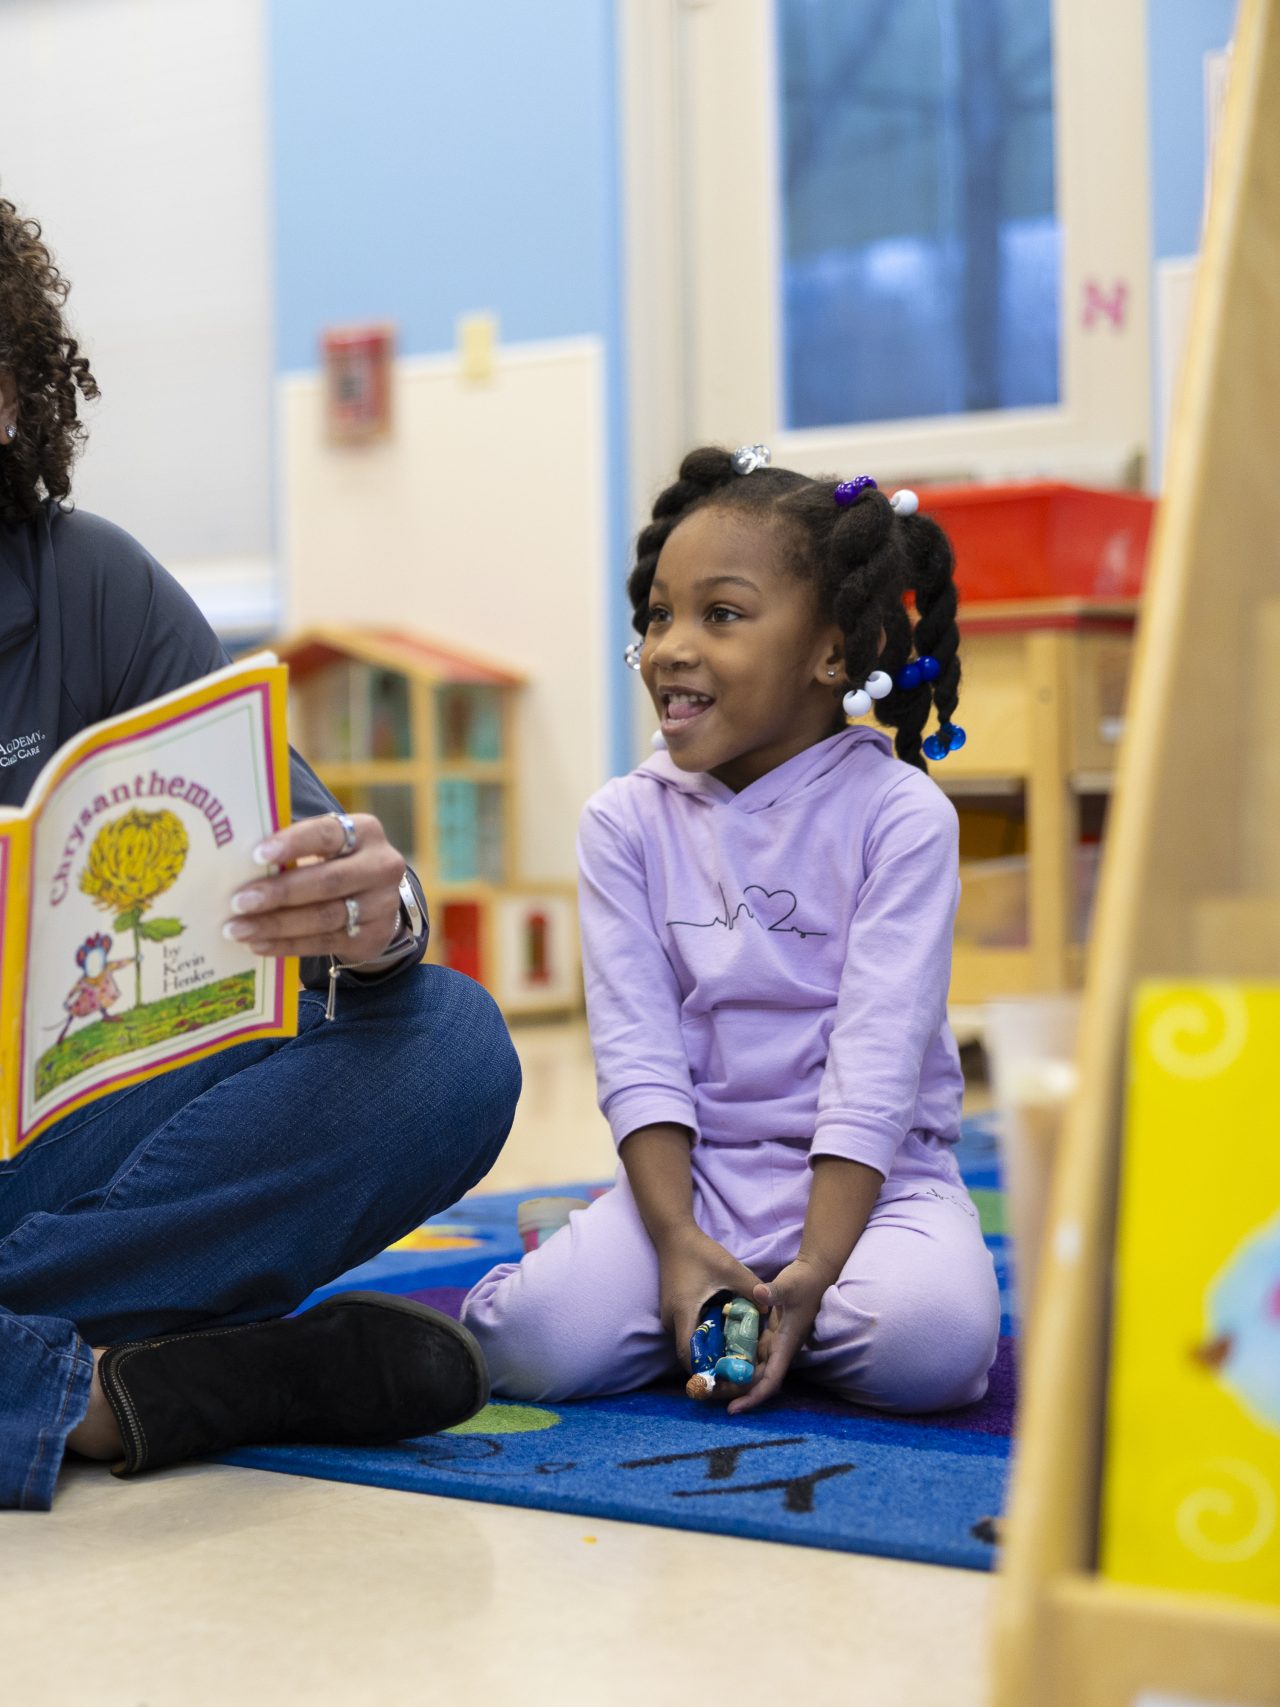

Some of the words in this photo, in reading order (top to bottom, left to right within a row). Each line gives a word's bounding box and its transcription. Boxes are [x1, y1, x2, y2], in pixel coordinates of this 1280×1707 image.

[0, 754, 18, 767] CHD
[17, 745, 40, 759] CARE
[49, 770, 234, 907] Chrysanthemum
[163, 945, 182, 964] by
[163, 953, 206, 976] Kevin
[163, 968, 215, 993] Henkes
